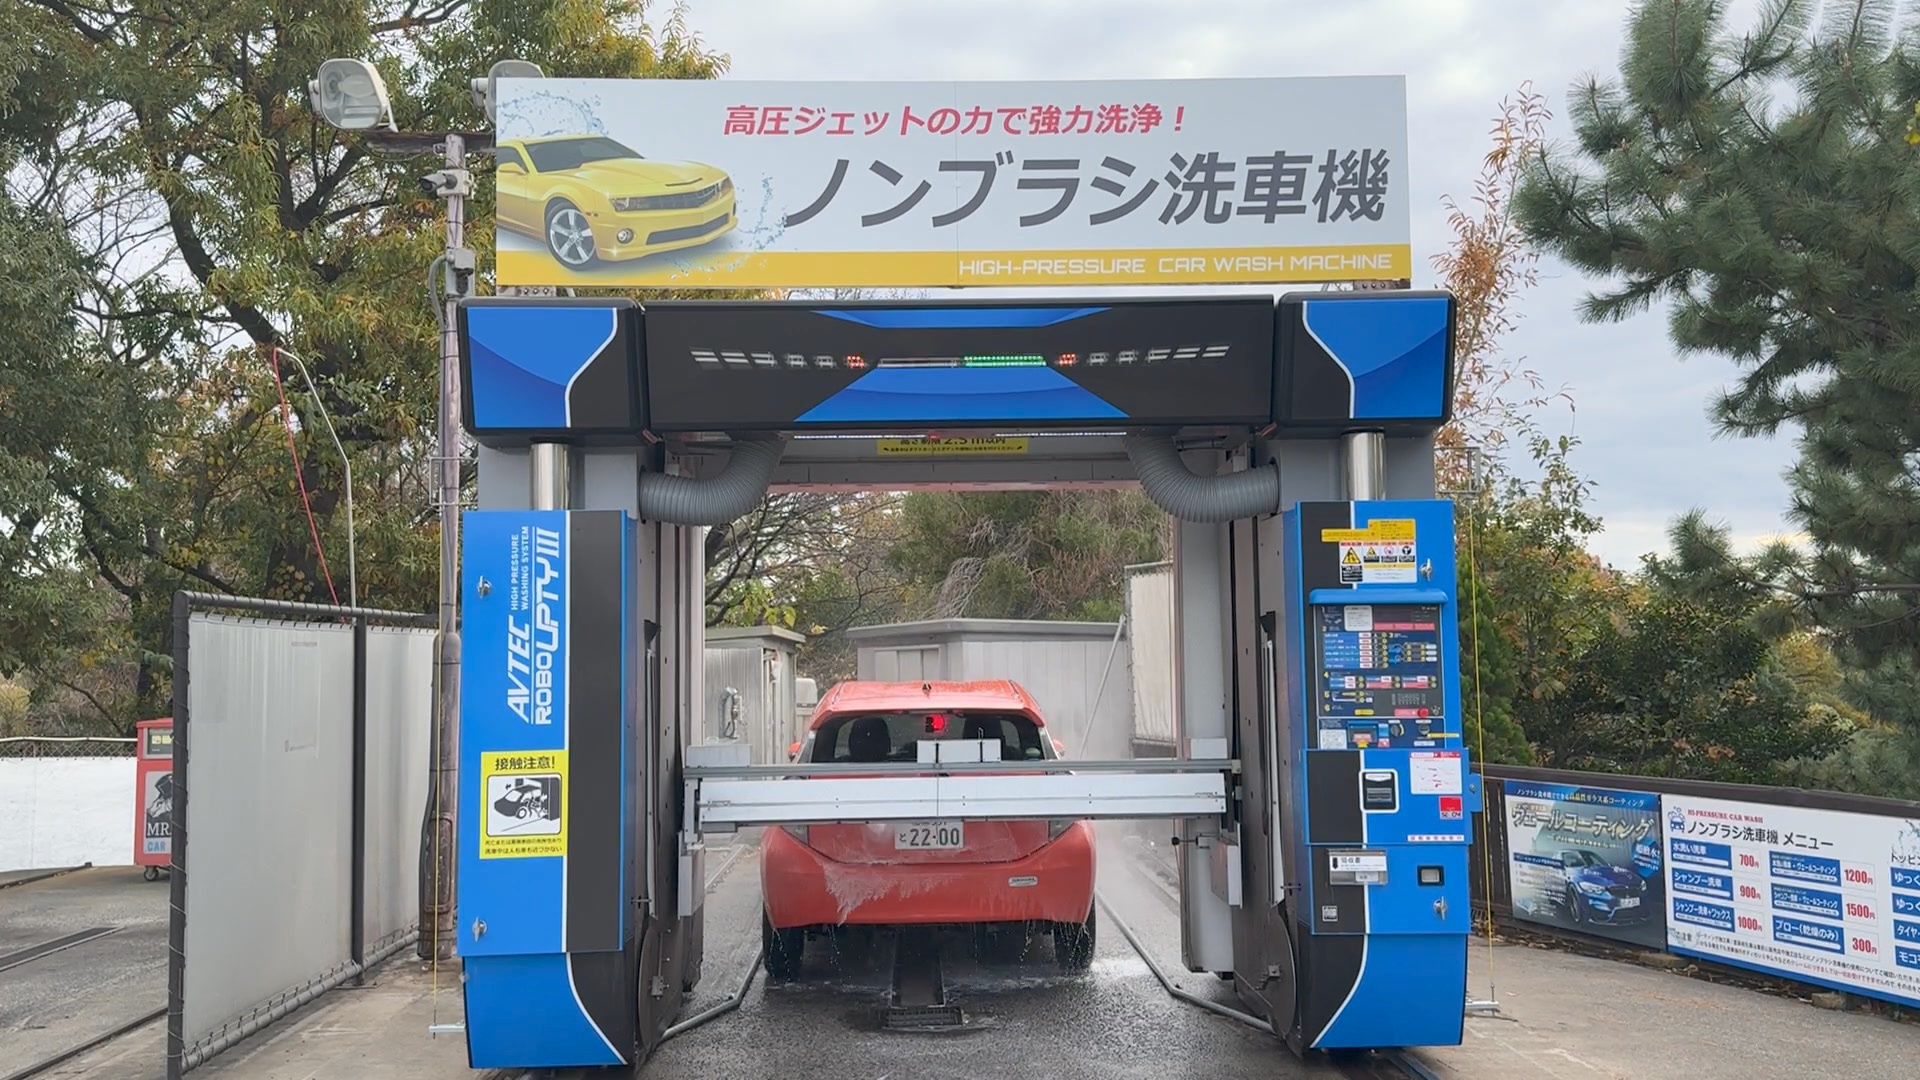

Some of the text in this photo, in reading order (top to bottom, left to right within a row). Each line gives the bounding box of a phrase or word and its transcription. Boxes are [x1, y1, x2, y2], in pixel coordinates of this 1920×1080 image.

[784, 148, 1391, 228] ノンブラシ洗車機
[959, 253, 1393, 276] HIGH-PRESSURE CAR WASH MACHINE
[521, 526, 529, 611] WASHING SYSTEM
[507, 614, 530, 724] AVTEC
[1512, 803, 1655, 841] ヴェールコーティング
[1743, 815, 1764, 824] WASH
[1687, 821, 1834, 850] ノンブラシ洗車機 メニュー
[147, 841, 166, 852] CAR
[1739, 853, 1760, 869] 700円
[1673, 871, 1723, 888] シャンプー洗車
[1844, 868, 1874, 885] 1200円
[1739, 885, 1761, 900] 900円
[1846, 902, 1876, 920] 1500円
[1737, 915, 1763, 932] 1000円
[1897, 924, 1920, 938] タイヤ
[1852, 937, 1878, 955] 300円
